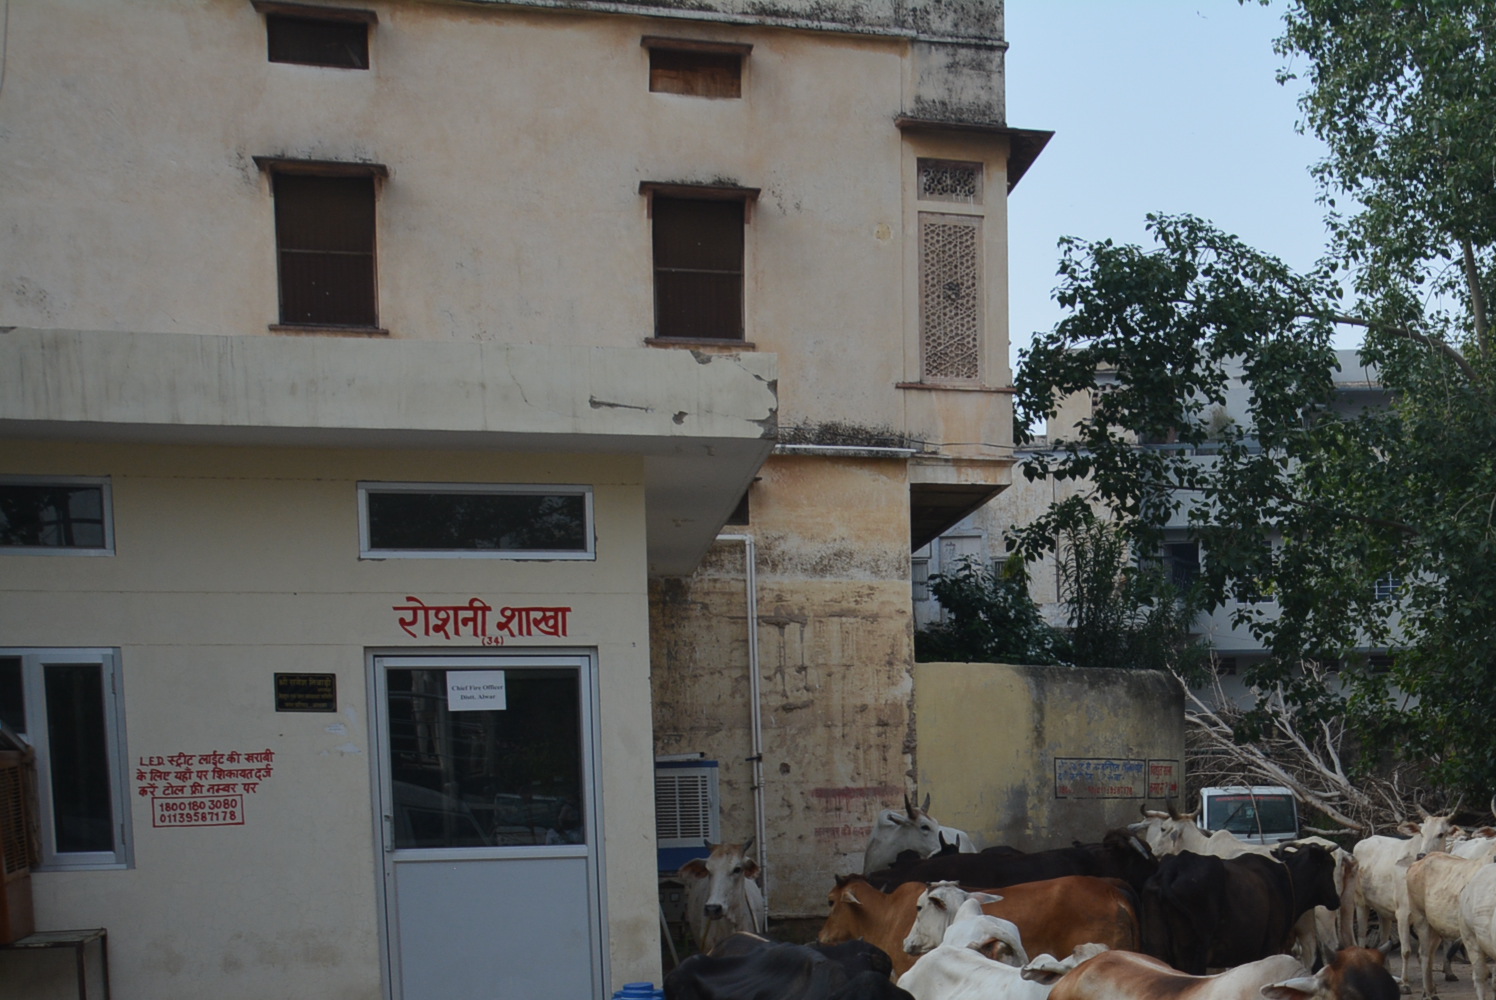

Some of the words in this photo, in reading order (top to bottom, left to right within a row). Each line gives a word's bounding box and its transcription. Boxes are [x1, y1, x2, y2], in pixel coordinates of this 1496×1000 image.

[392, 596, 492, 640] रोशनी
[496, 606, 572, 638] शाखा
[482, 636, 504, 646] (34)
[166, 752, 196, 768] स्ट्रीट
[226, 750, 242, 764] की
[244, 748, 276, 763] खराबी
[136, 768, 148, 781] के
[149, 768, 172, 781] लिए
[196, 770, 210, 780] पर
[211, 767, 255, 780] शिकायत
[254, 763, 274, 782] दर्ज
[138, 782, 159, 796] करें
[162, 782, 187, 796] टोल
[189, 781, 206, 796] फ्री
[206, 783, 239, 794] नम्बर
[241, 782, 260, 794] पर
